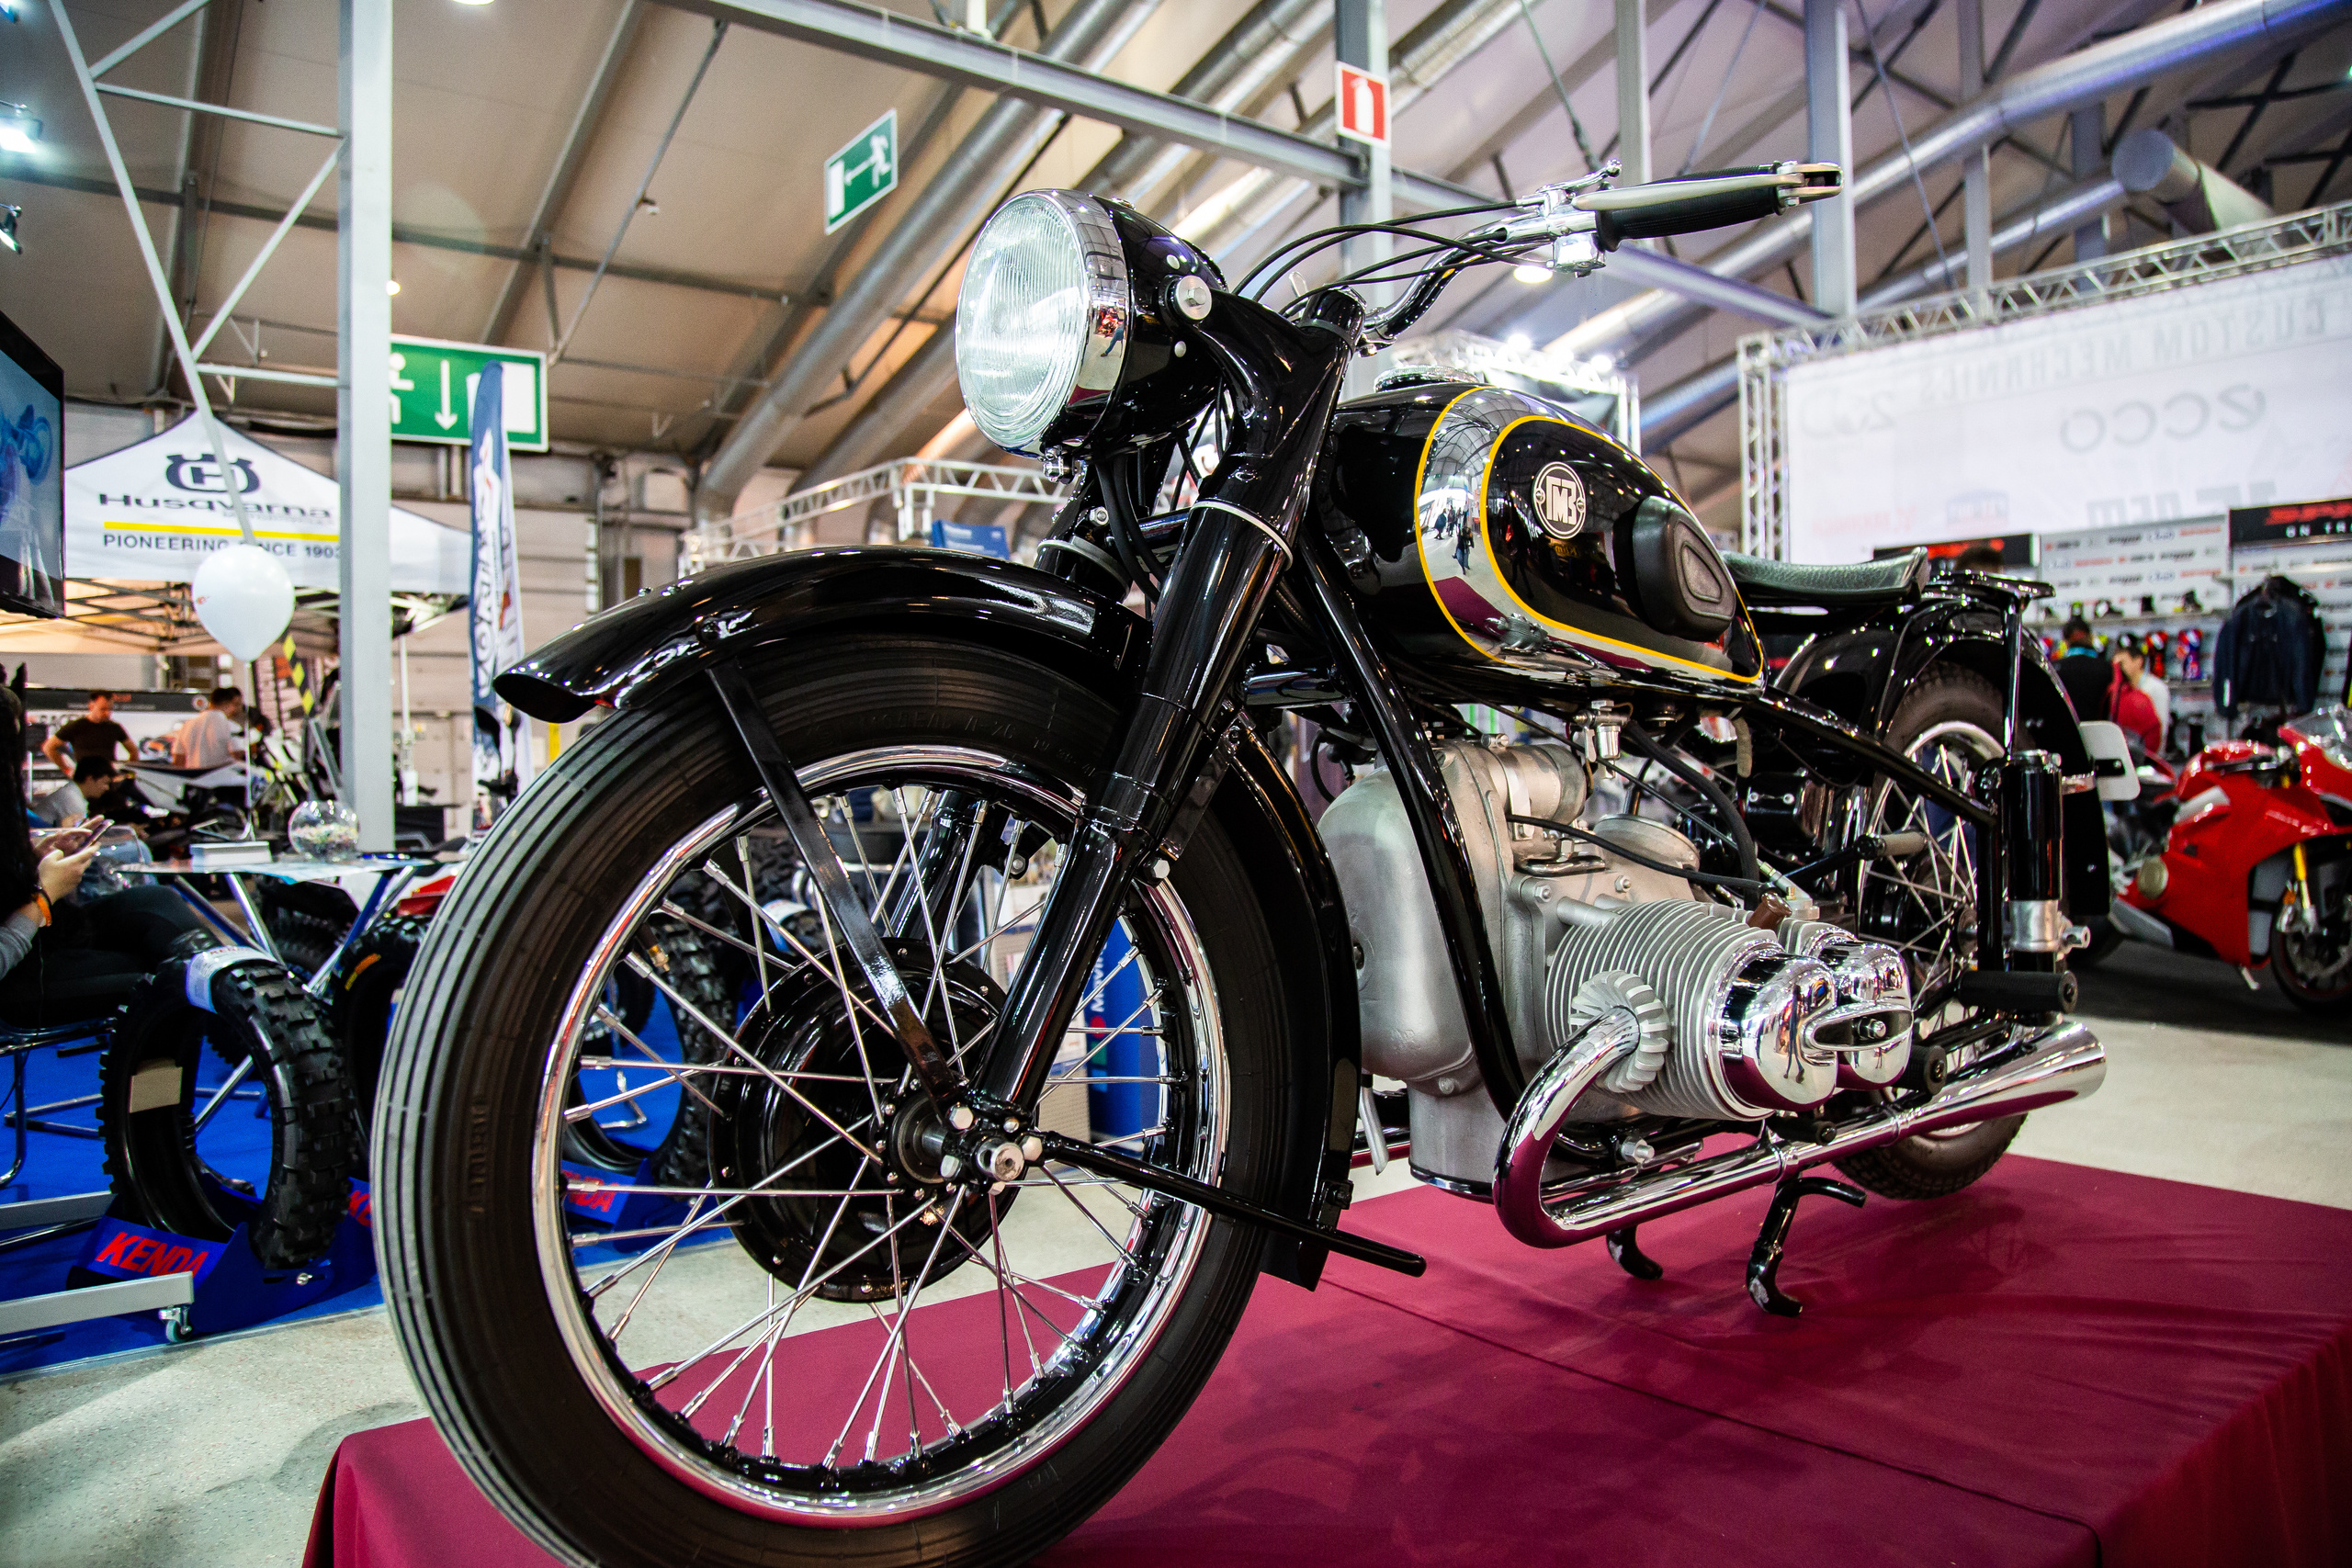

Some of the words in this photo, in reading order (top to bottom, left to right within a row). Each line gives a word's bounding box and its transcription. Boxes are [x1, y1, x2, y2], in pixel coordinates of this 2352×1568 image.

[98, 493, 331, 519] Husqvarna
[239, 540, 297, 557] NCE
[95, 1232, 209, 1279] KENDA
